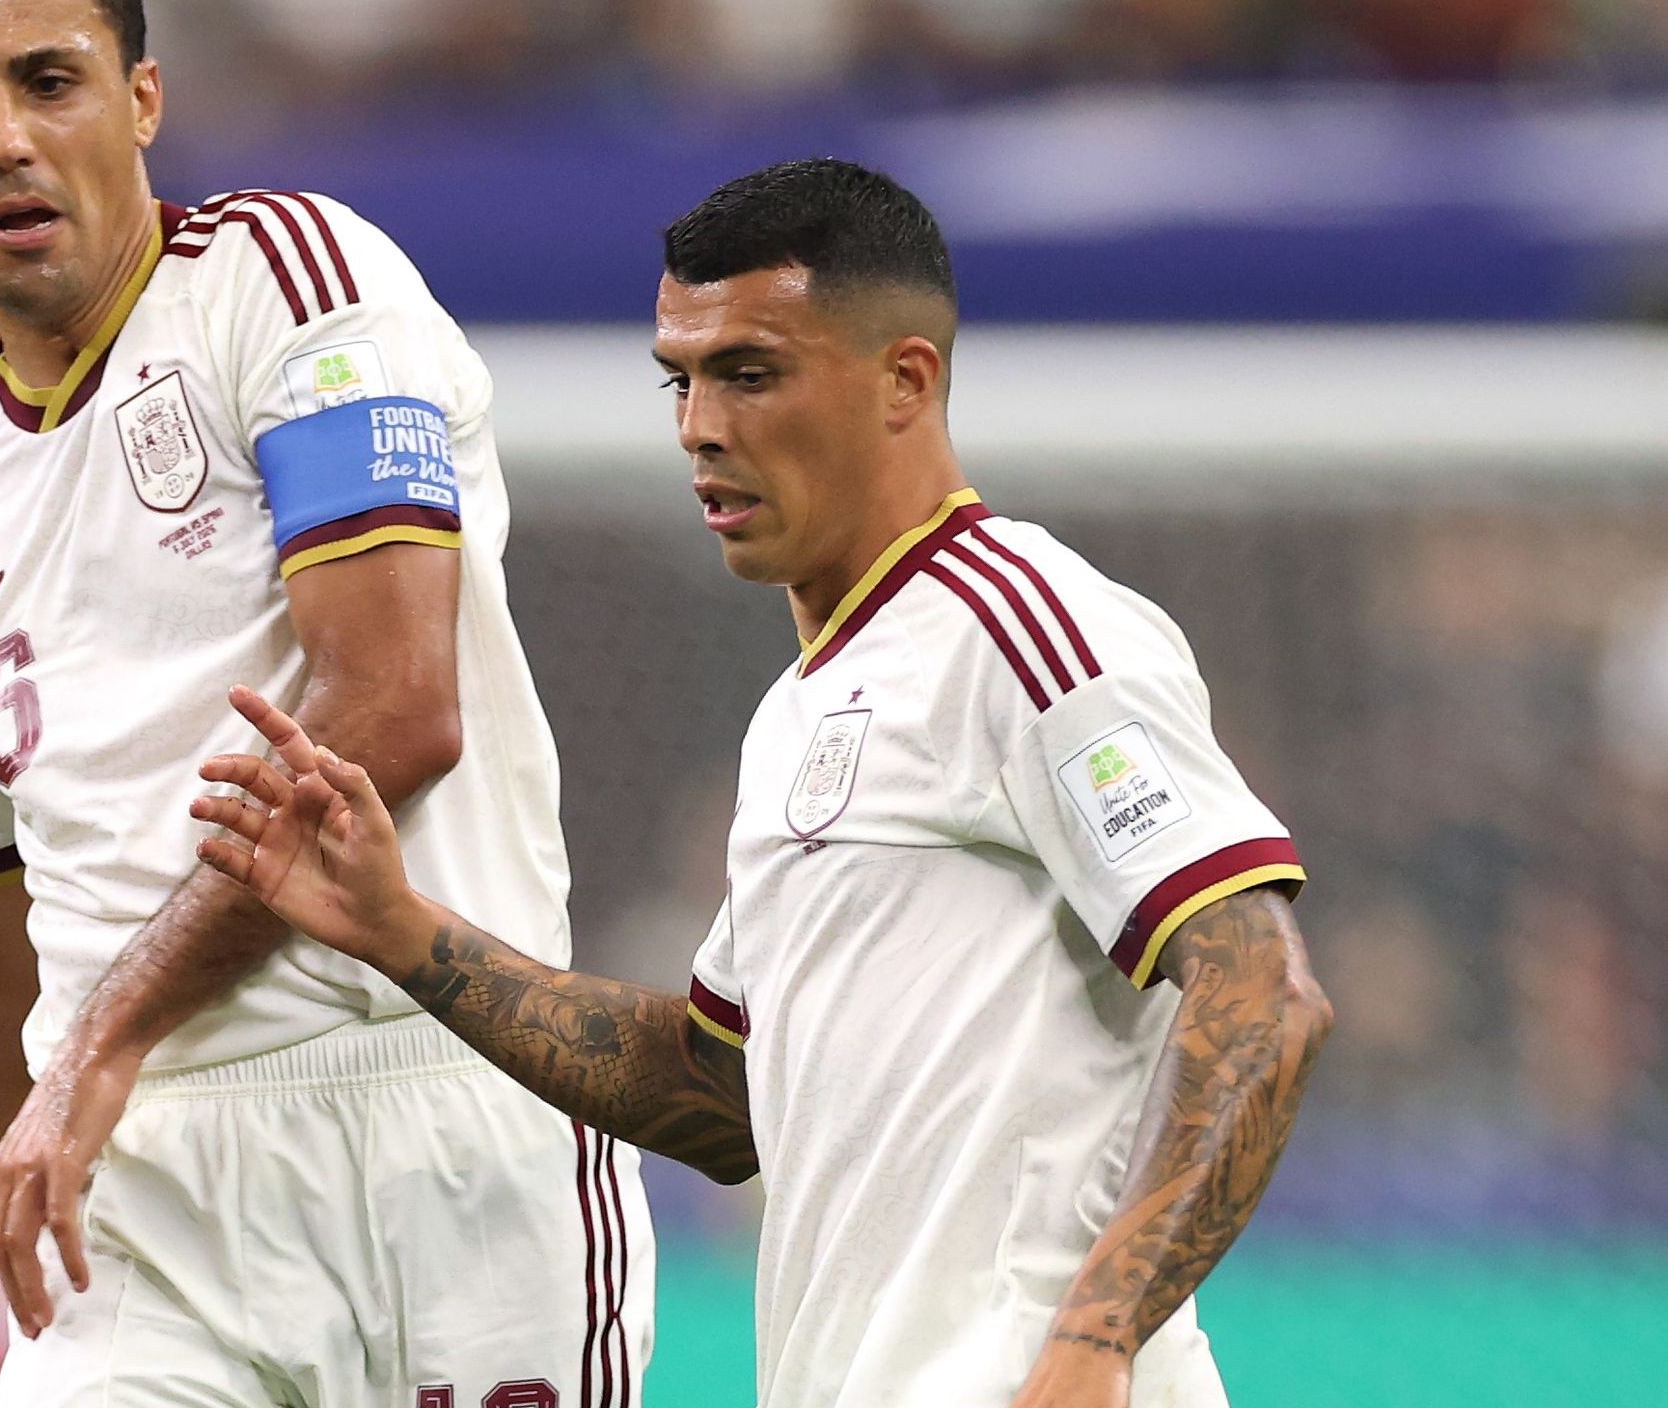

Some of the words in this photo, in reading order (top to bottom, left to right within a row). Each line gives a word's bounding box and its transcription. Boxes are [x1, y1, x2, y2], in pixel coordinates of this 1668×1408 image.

[372, 427, 452, 468] UNITE
[366, 454, 416, 482] the
[1102, 788, 1172, 838] EDUCATION
[1129, 817, 1157, 838] FIFA
